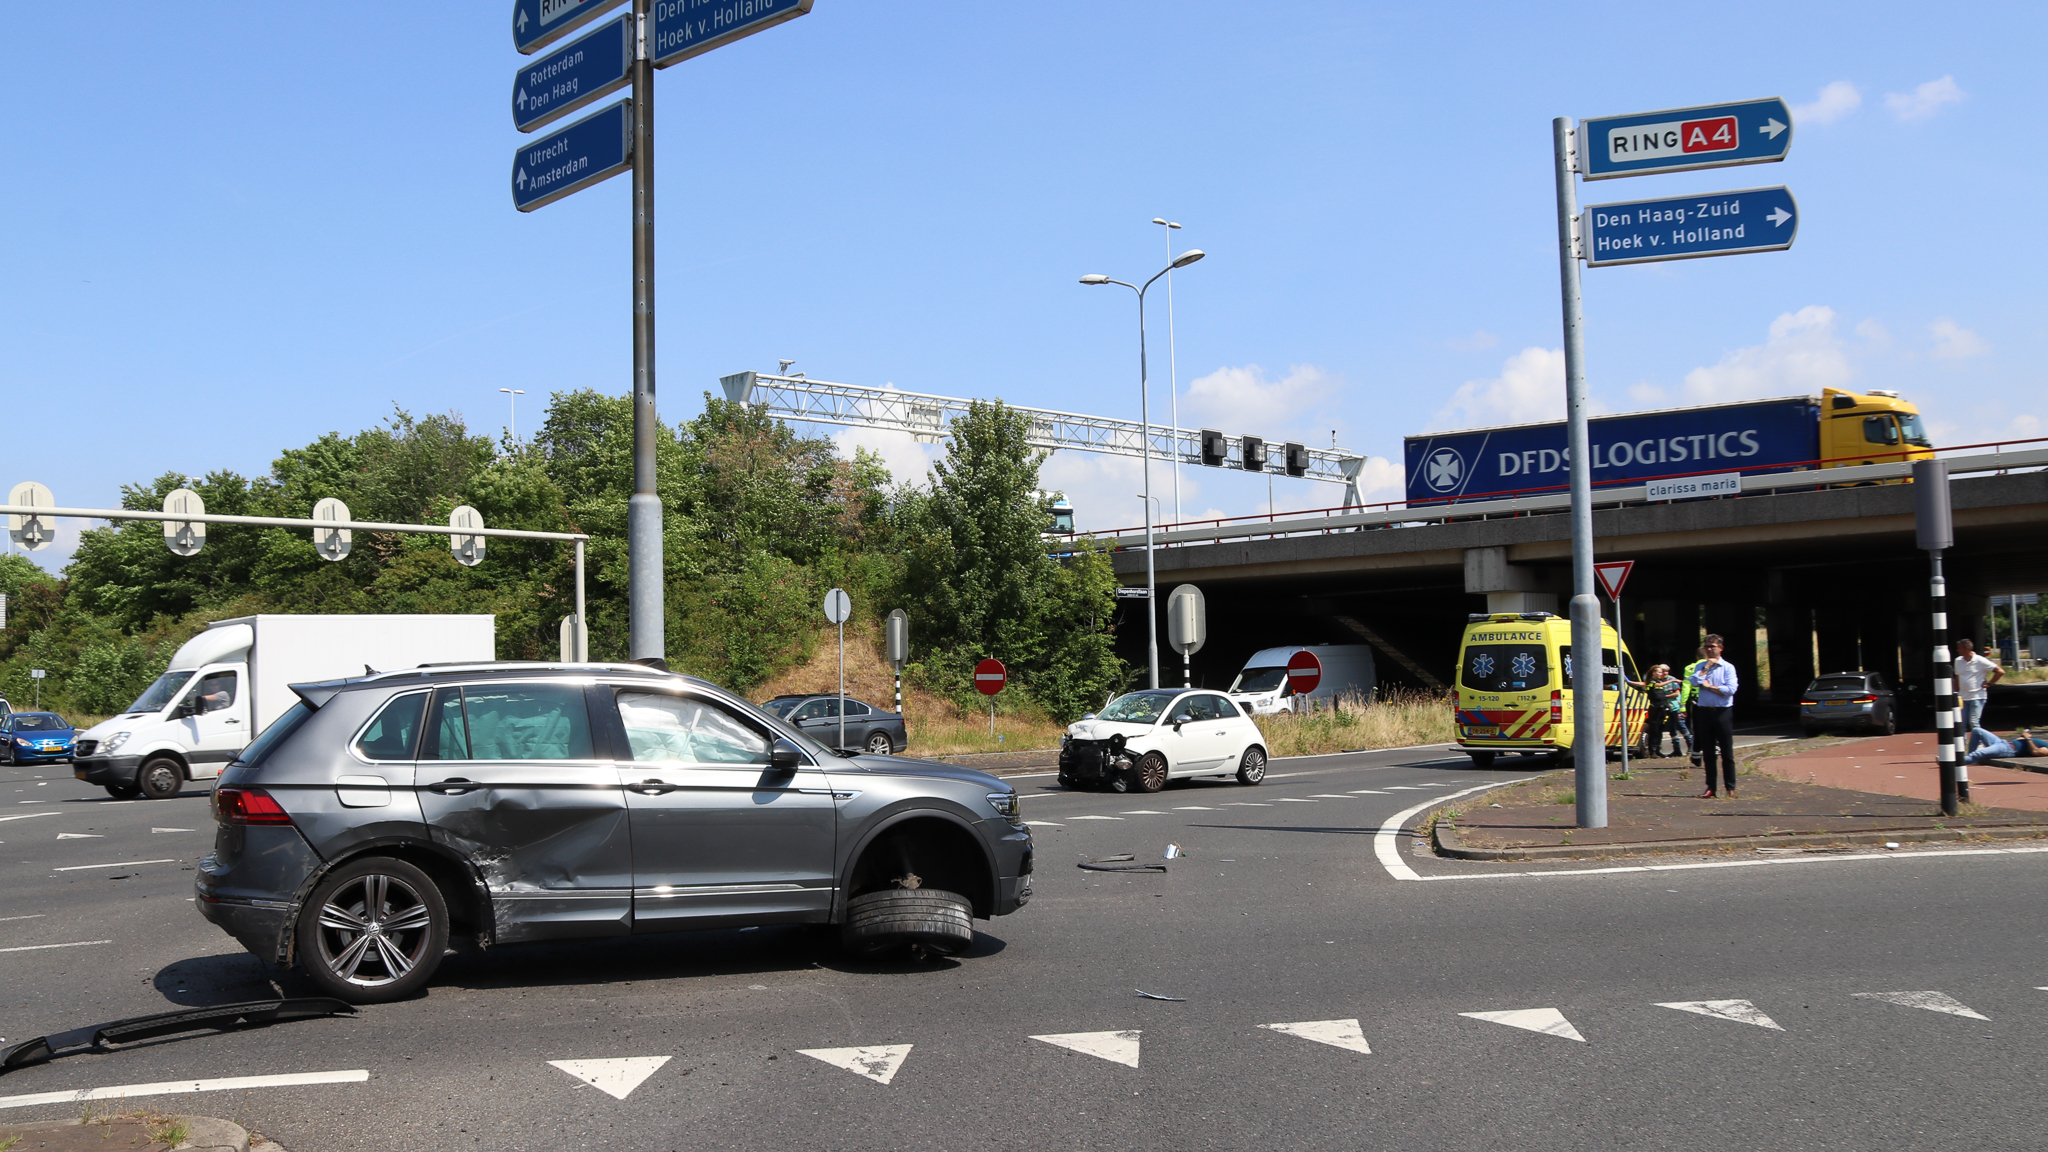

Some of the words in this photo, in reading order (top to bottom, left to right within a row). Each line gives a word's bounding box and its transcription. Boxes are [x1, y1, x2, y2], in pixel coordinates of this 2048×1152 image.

[658, 0, 685, 22] Den
[658, 21, 693, 51] Hoek
[698, 18, 710, 35] v.
[530, 50, 584, 87] Rotterdam
[530, 93, 549, 111] Den
[552, 77, 578, 100] Haag
[529, 137, 568, 166] Utrecht
[1613, 131, 1678, 154] RING
[1687, 123, 1732, 147] A4
[529, 156, 588, 191] Amsterdam
[1597, 213, 1631, 228] Den
[1638, 200, 1740, 224] Haag-Zuid
[1598, 233, 1643, 251] Hoek
[1649, 234, 1665, 246] v.
[1673, 223, 1745, 244] Holland
[1593, 430, 1759, 468] LOGISTICS
[1650, 483, 1697, 496] clarissa
[1701, 478, 1737, 491] maria
[1470, 632, 1542, 641] AMBULANCE
